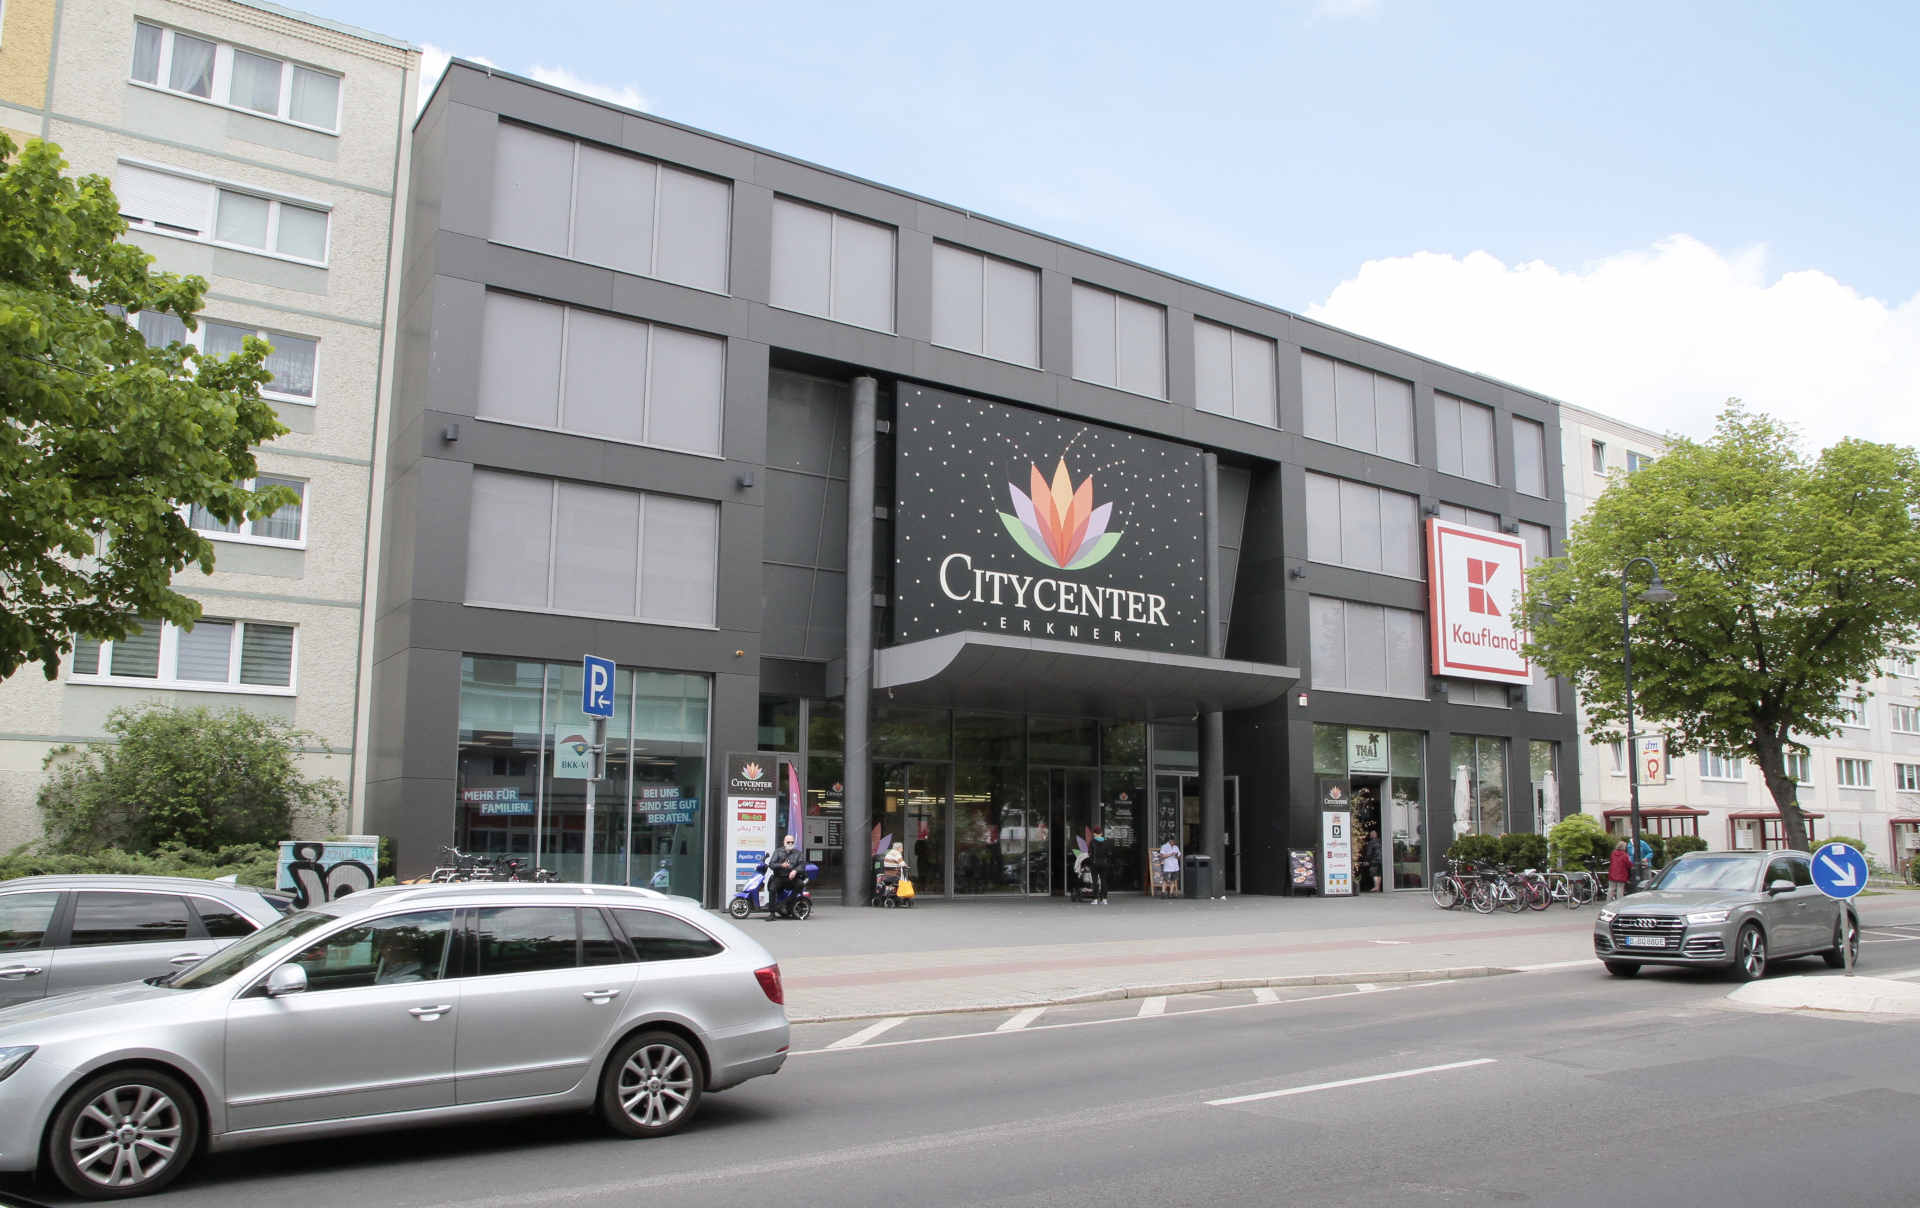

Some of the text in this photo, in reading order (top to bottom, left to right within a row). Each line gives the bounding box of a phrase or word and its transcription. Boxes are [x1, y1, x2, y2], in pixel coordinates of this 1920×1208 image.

[939, 553, 1169, 626] CITYCENTER
[1000, 616, 1122, 642] ERKNER
[1452, 623, 1518, 651] Kaufland
[590, 664, 608, 707] P
[464, 788, 517, 801] MEHR FÜR
[643, 787, 679, 798] BEI UNS
[482, 802, 531, 814] FAMILIEN.
[639, 799, 697, 811] SIND SIE GUT
[648, 813, 692, 823] BERATEN.
